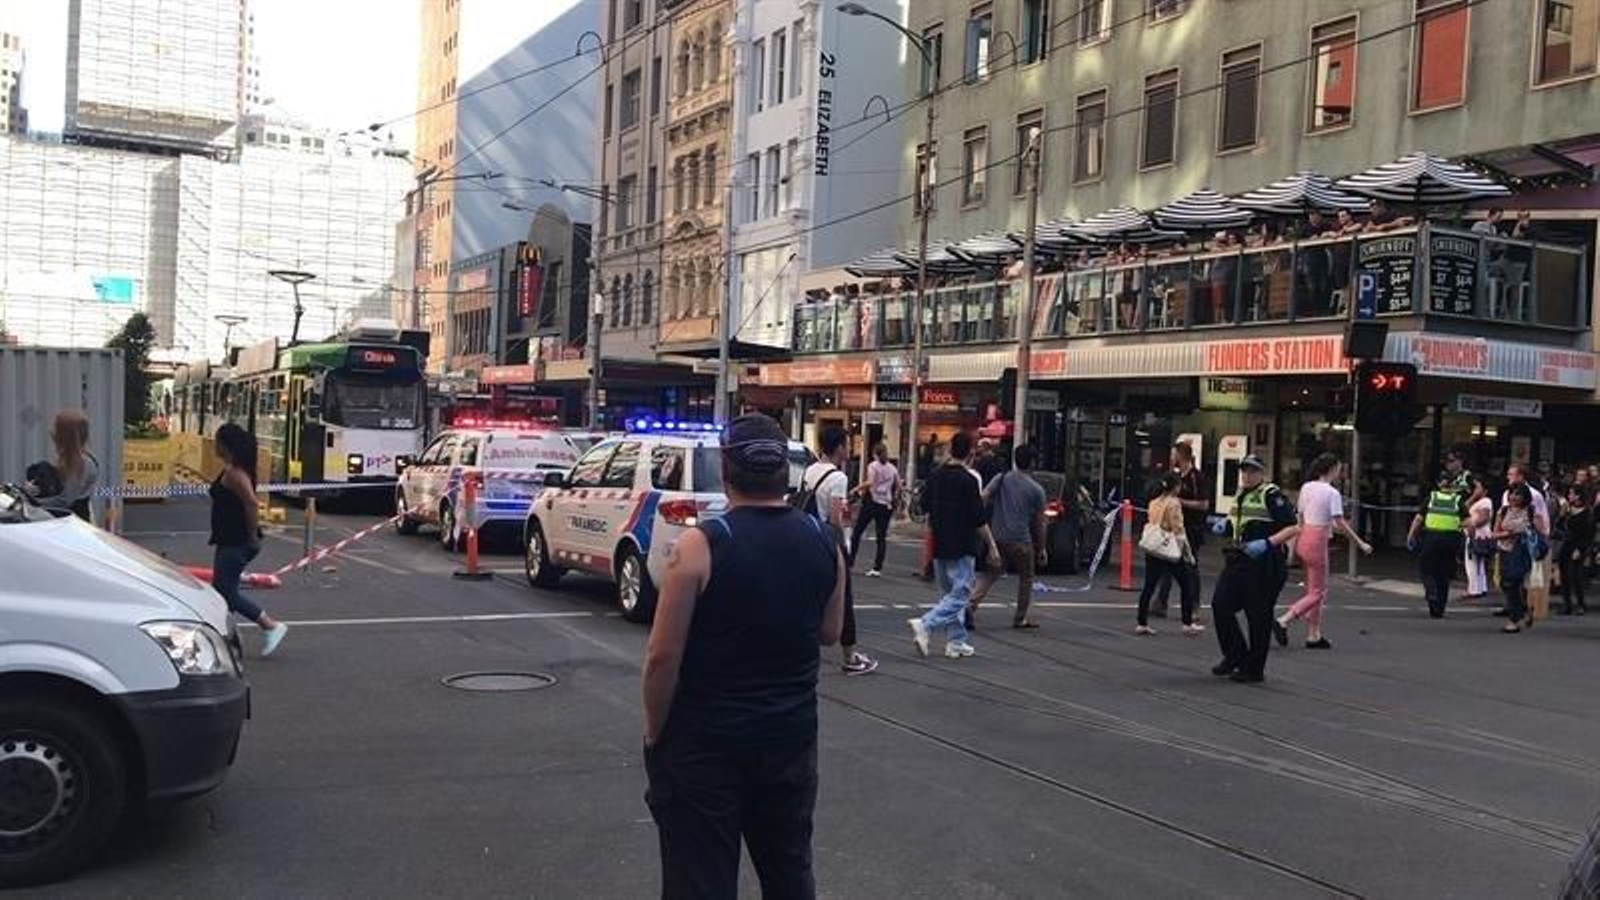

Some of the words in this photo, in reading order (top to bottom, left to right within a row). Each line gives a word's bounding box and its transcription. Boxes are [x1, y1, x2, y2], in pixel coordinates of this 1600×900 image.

[820, 51, 835, 78] 25
[815, 90, 832, 176] ELIZABETH
[1359, 275, 1374, 299] P
[1208, 342, 1270, 372] FLINDERS
[1273, 339, 1334, 370] STATION
[924, 388, 955, 402] Forex
[490, 445, 579, 461] Ambulance
